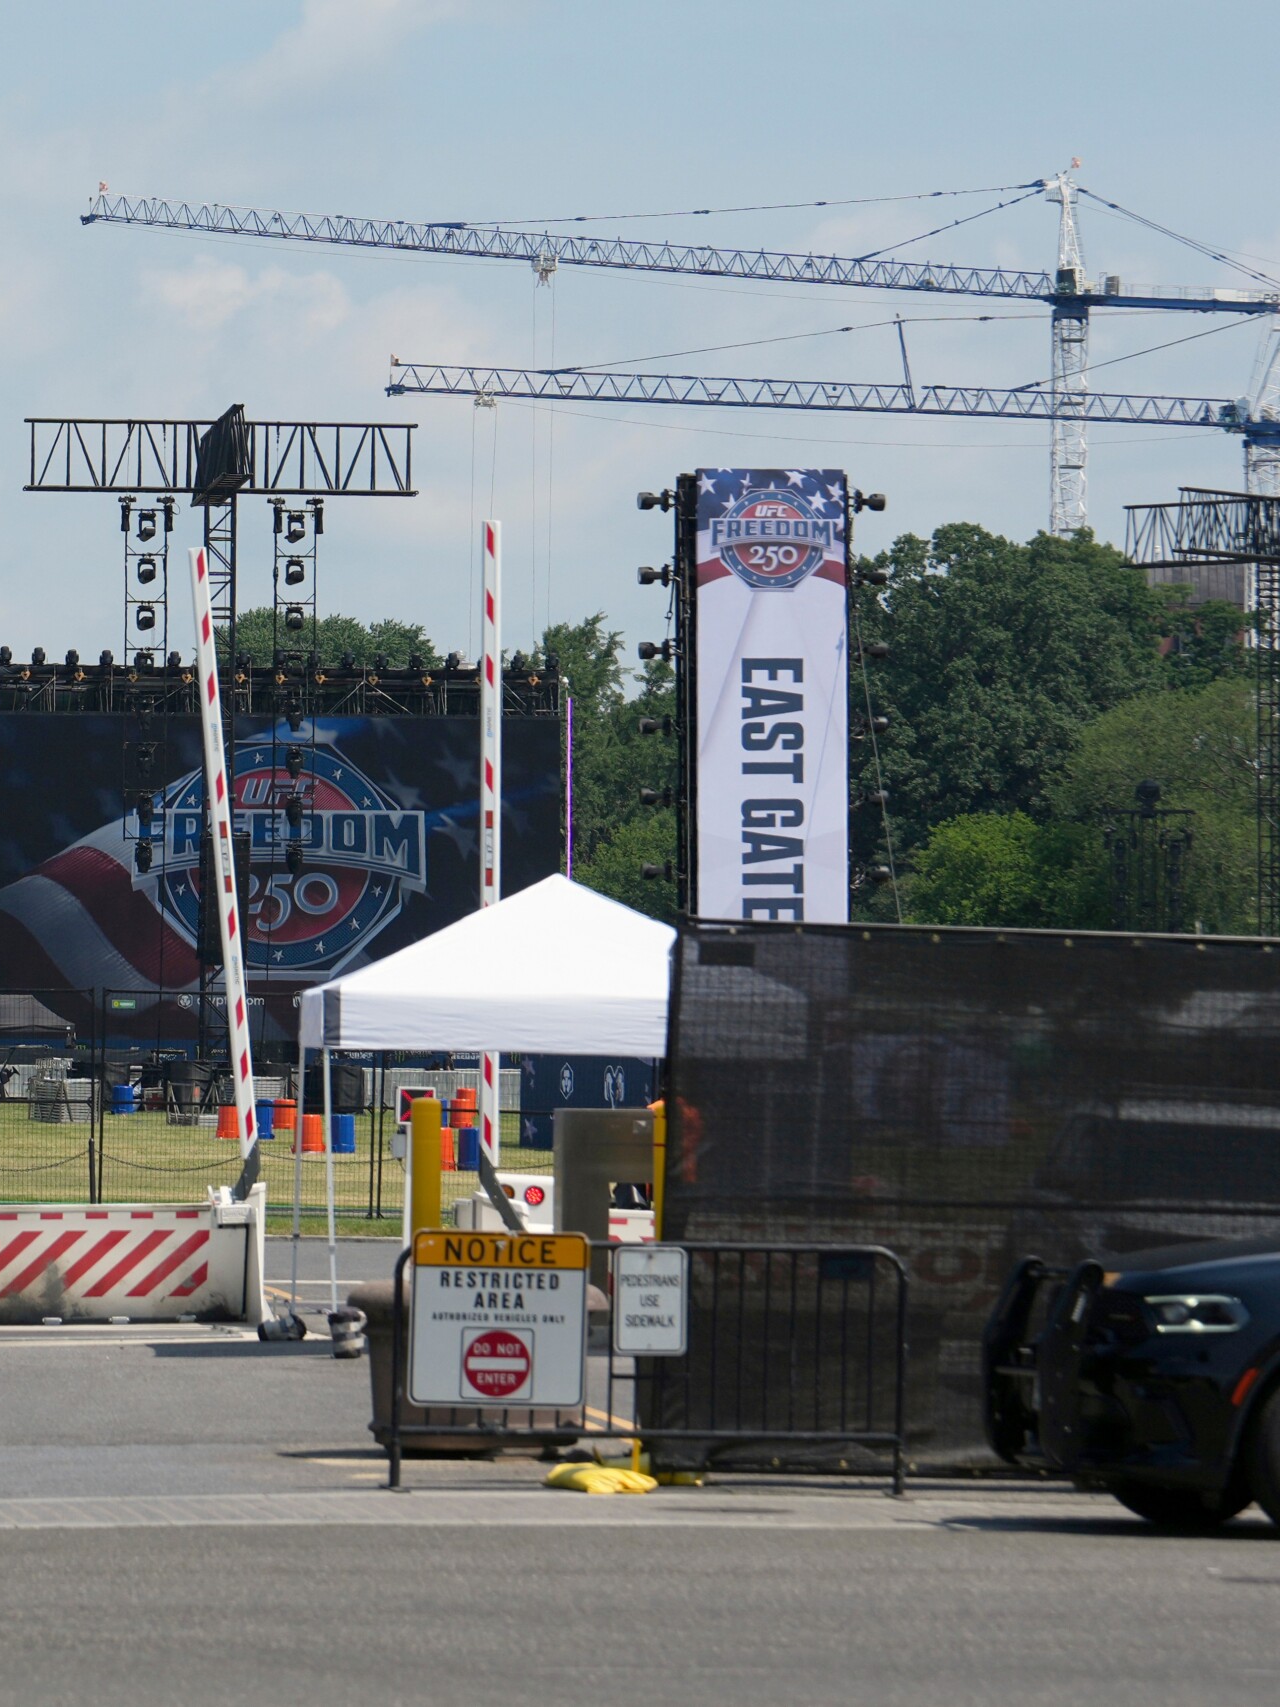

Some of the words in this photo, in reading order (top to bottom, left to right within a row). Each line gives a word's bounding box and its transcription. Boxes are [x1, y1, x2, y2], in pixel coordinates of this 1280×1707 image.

[754, 505, 789, 517] UFC
[711, 520, 831, 548] FREEDOM
[748, 545, 798, 572] 250
[741, 657, 804, 783] EAST
[741, 798, 804, 921] GATE
[444, 1238, 557, 1265] NOTICE
[440, 1271, 560, 1290] RESTRICTED
[620, 1274, 680, 1288] PEDESTRIANS
[474, 1292, 525, 1309] AREA
[639, 1294, 660, 1308] USE
[432, 1312, 489, 1321] AUTHORIZED
[494, 1314, 538, 1323] VEHICLES
[542, 1315, 565, 1324] ONLY
[625, 1314, 675, 1328] SIDEWALK
[473, 1343, 491, 1354] DO
[497, 1343, 521, 1355] NOT
[477, 1373, 516, 1385] ENTER
